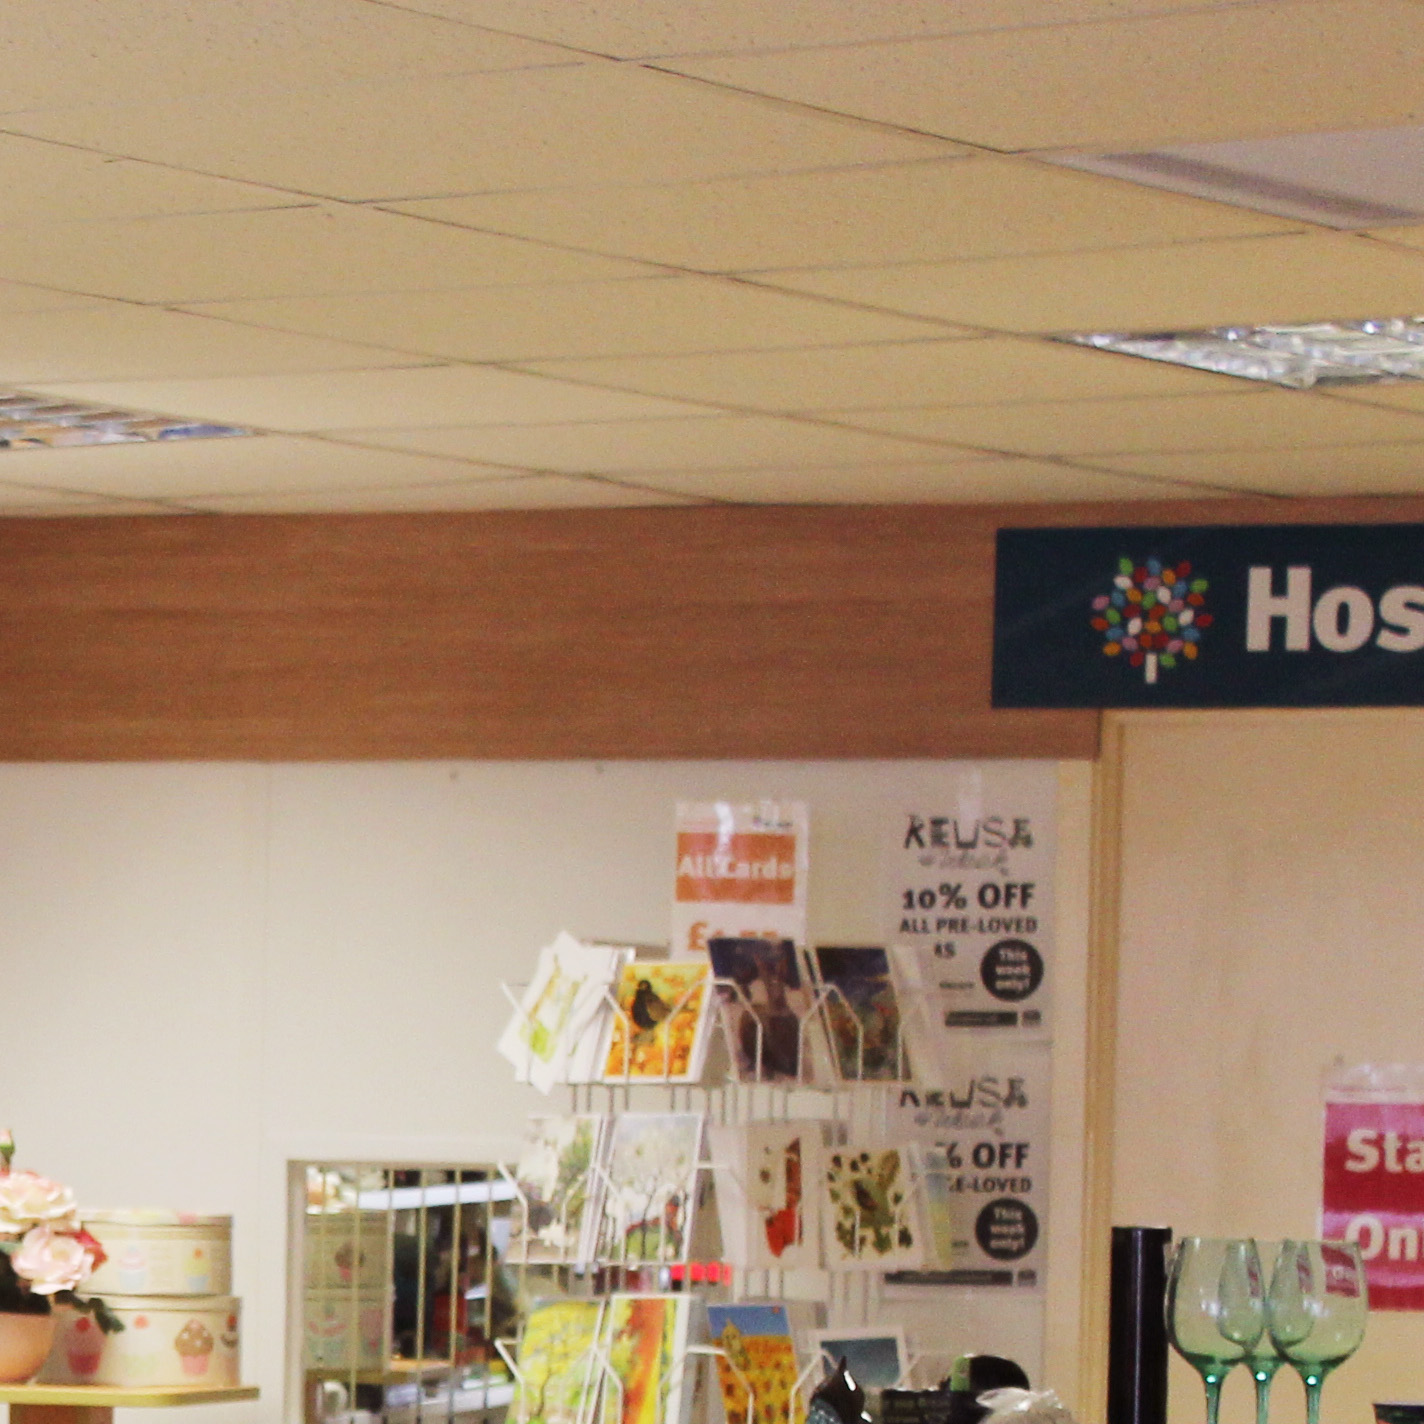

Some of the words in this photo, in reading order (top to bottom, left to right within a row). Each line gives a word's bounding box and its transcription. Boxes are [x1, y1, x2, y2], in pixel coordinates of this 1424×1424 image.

[904, 814, 1034, 850] REUSE
[902, 882, 968, 910] 10%
[977, 881, 1036, 910] OFF
[900, 918, 930, 935] ALL
[936, 917, 1038, 935] PRE-LOVED
[972, 1141, 1030, 1169] OFF
[949, 1176, 1032, 1193] E-LOVED
